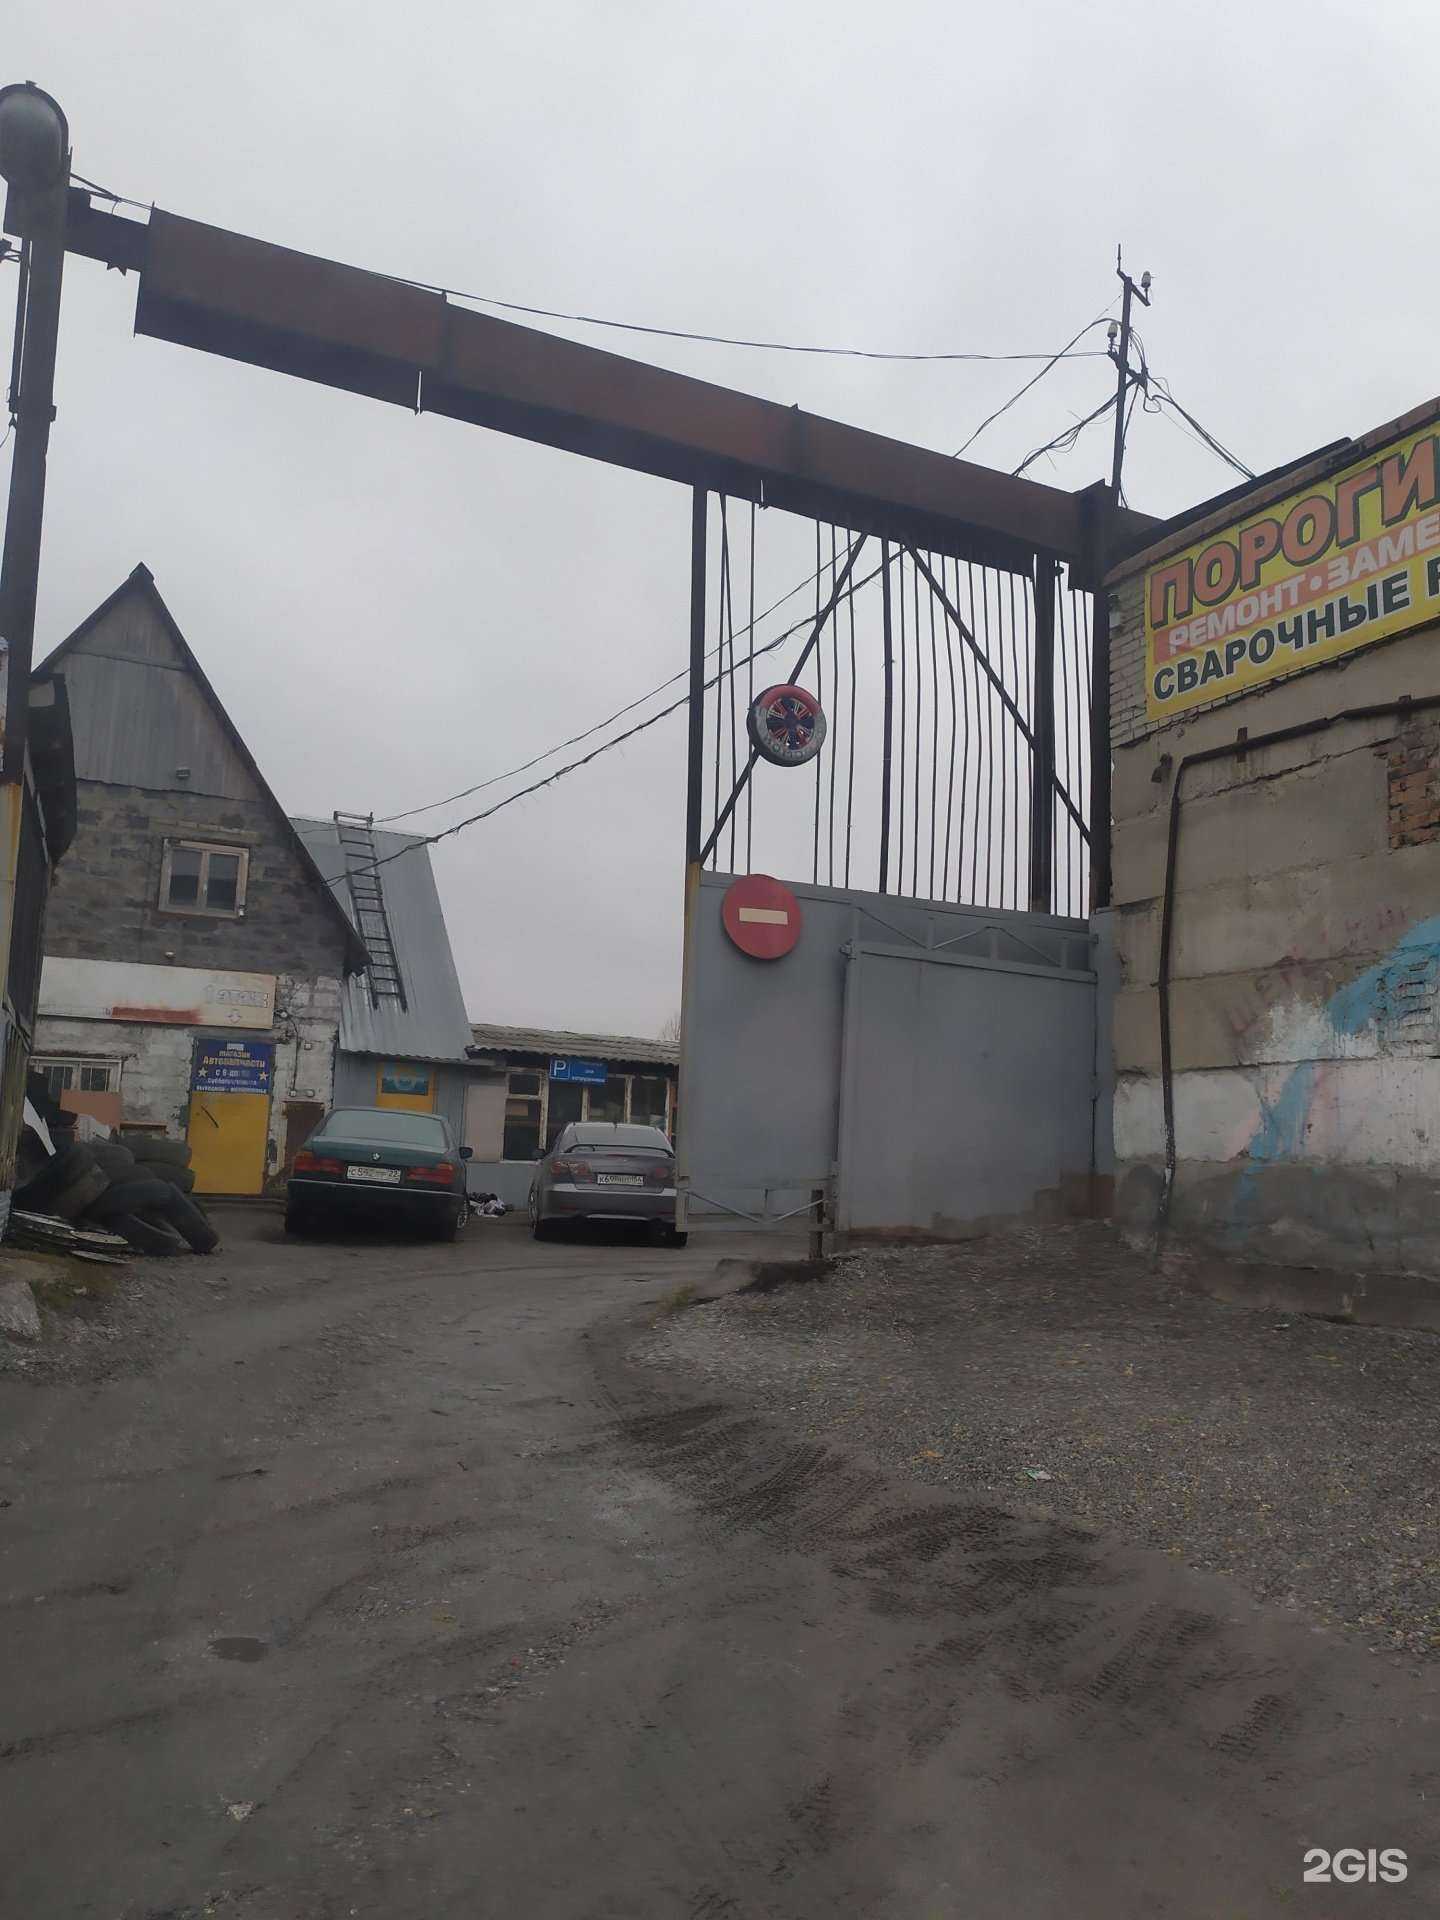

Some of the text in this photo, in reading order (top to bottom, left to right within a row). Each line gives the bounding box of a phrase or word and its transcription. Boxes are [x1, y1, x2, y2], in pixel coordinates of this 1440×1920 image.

[1151, 434, 1440, 629] ПОРОГИ
[1153, 571, 1411, 700] СВАРОЧНЫЕ
[1168, 572, 1307, 656] РЕМОНТ
[554, 1060, 567, 1077] P
